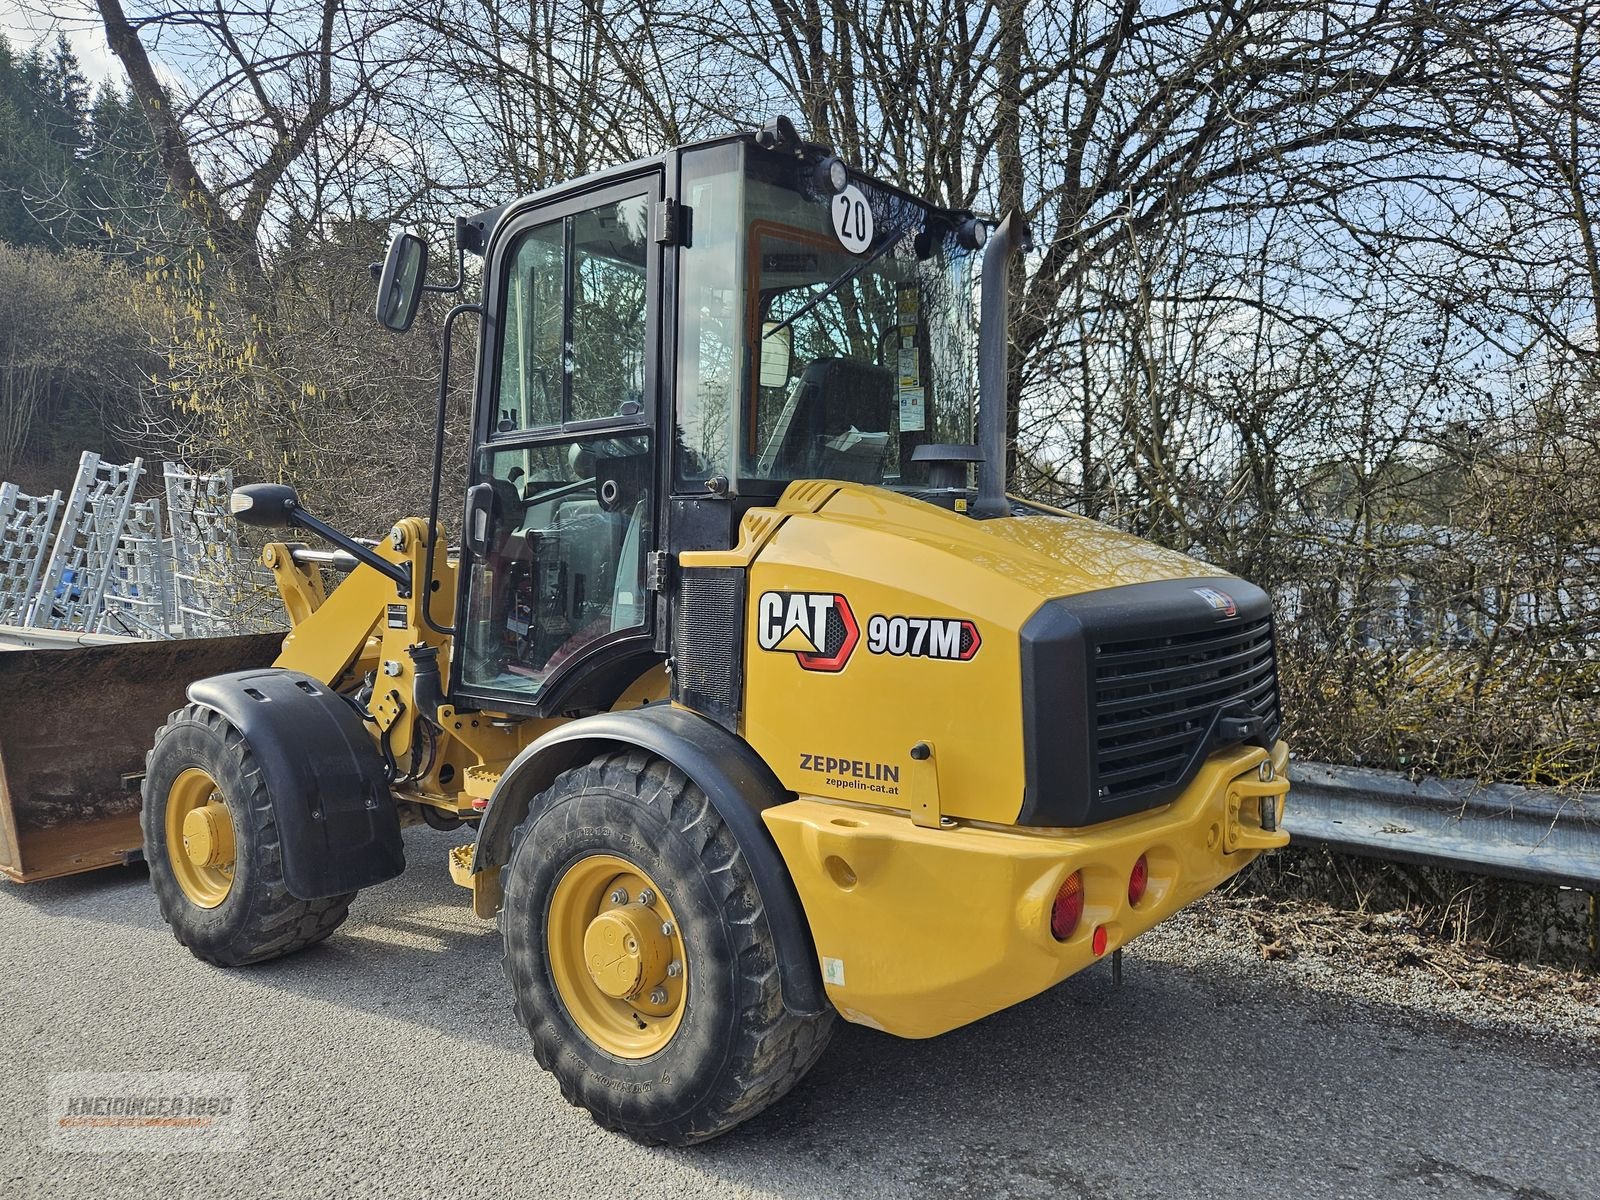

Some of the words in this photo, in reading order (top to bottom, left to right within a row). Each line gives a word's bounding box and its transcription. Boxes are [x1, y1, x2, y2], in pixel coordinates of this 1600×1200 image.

[840, 195, 866, 242] 20
[758, 591, 834, 653] CAT
[868, 615, 962, 659] 907M
[799, 753, 899, 783] ZEPPELIN
[826, 777, 899, 795] zeppelin-cat.at
[590, 1071, 653, 1094] DUNLOP
